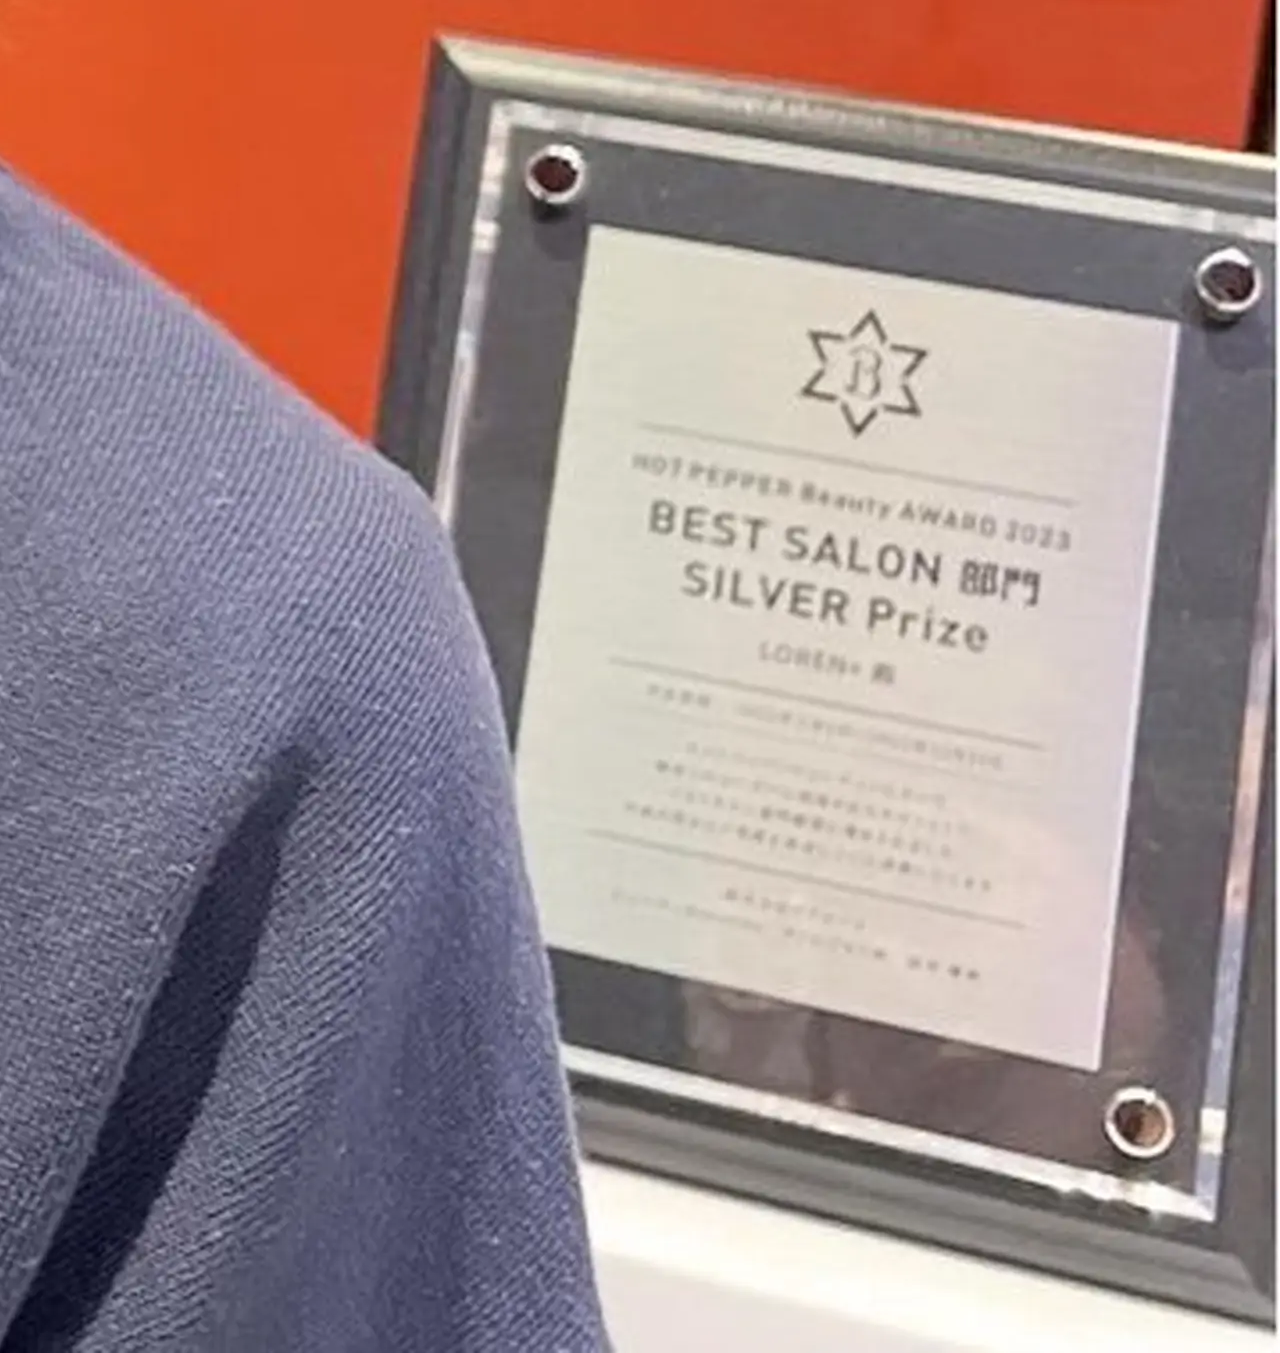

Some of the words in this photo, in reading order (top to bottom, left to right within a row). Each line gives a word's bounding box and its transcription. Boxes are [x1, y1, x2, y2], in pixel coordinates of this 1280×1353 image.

[631, 452, 682, 478] HOT
[689, 460, 793, 496] PEPPER
[800, 481, 890, 521] Beauty
[898, 499, 997, 539] AWARD
[648, 498, 770, 553] BEST
[781, 524, 942, 587] SALON
[680, 559, 851, 627] SILVER
[866, 594, 990, 654] Prize
